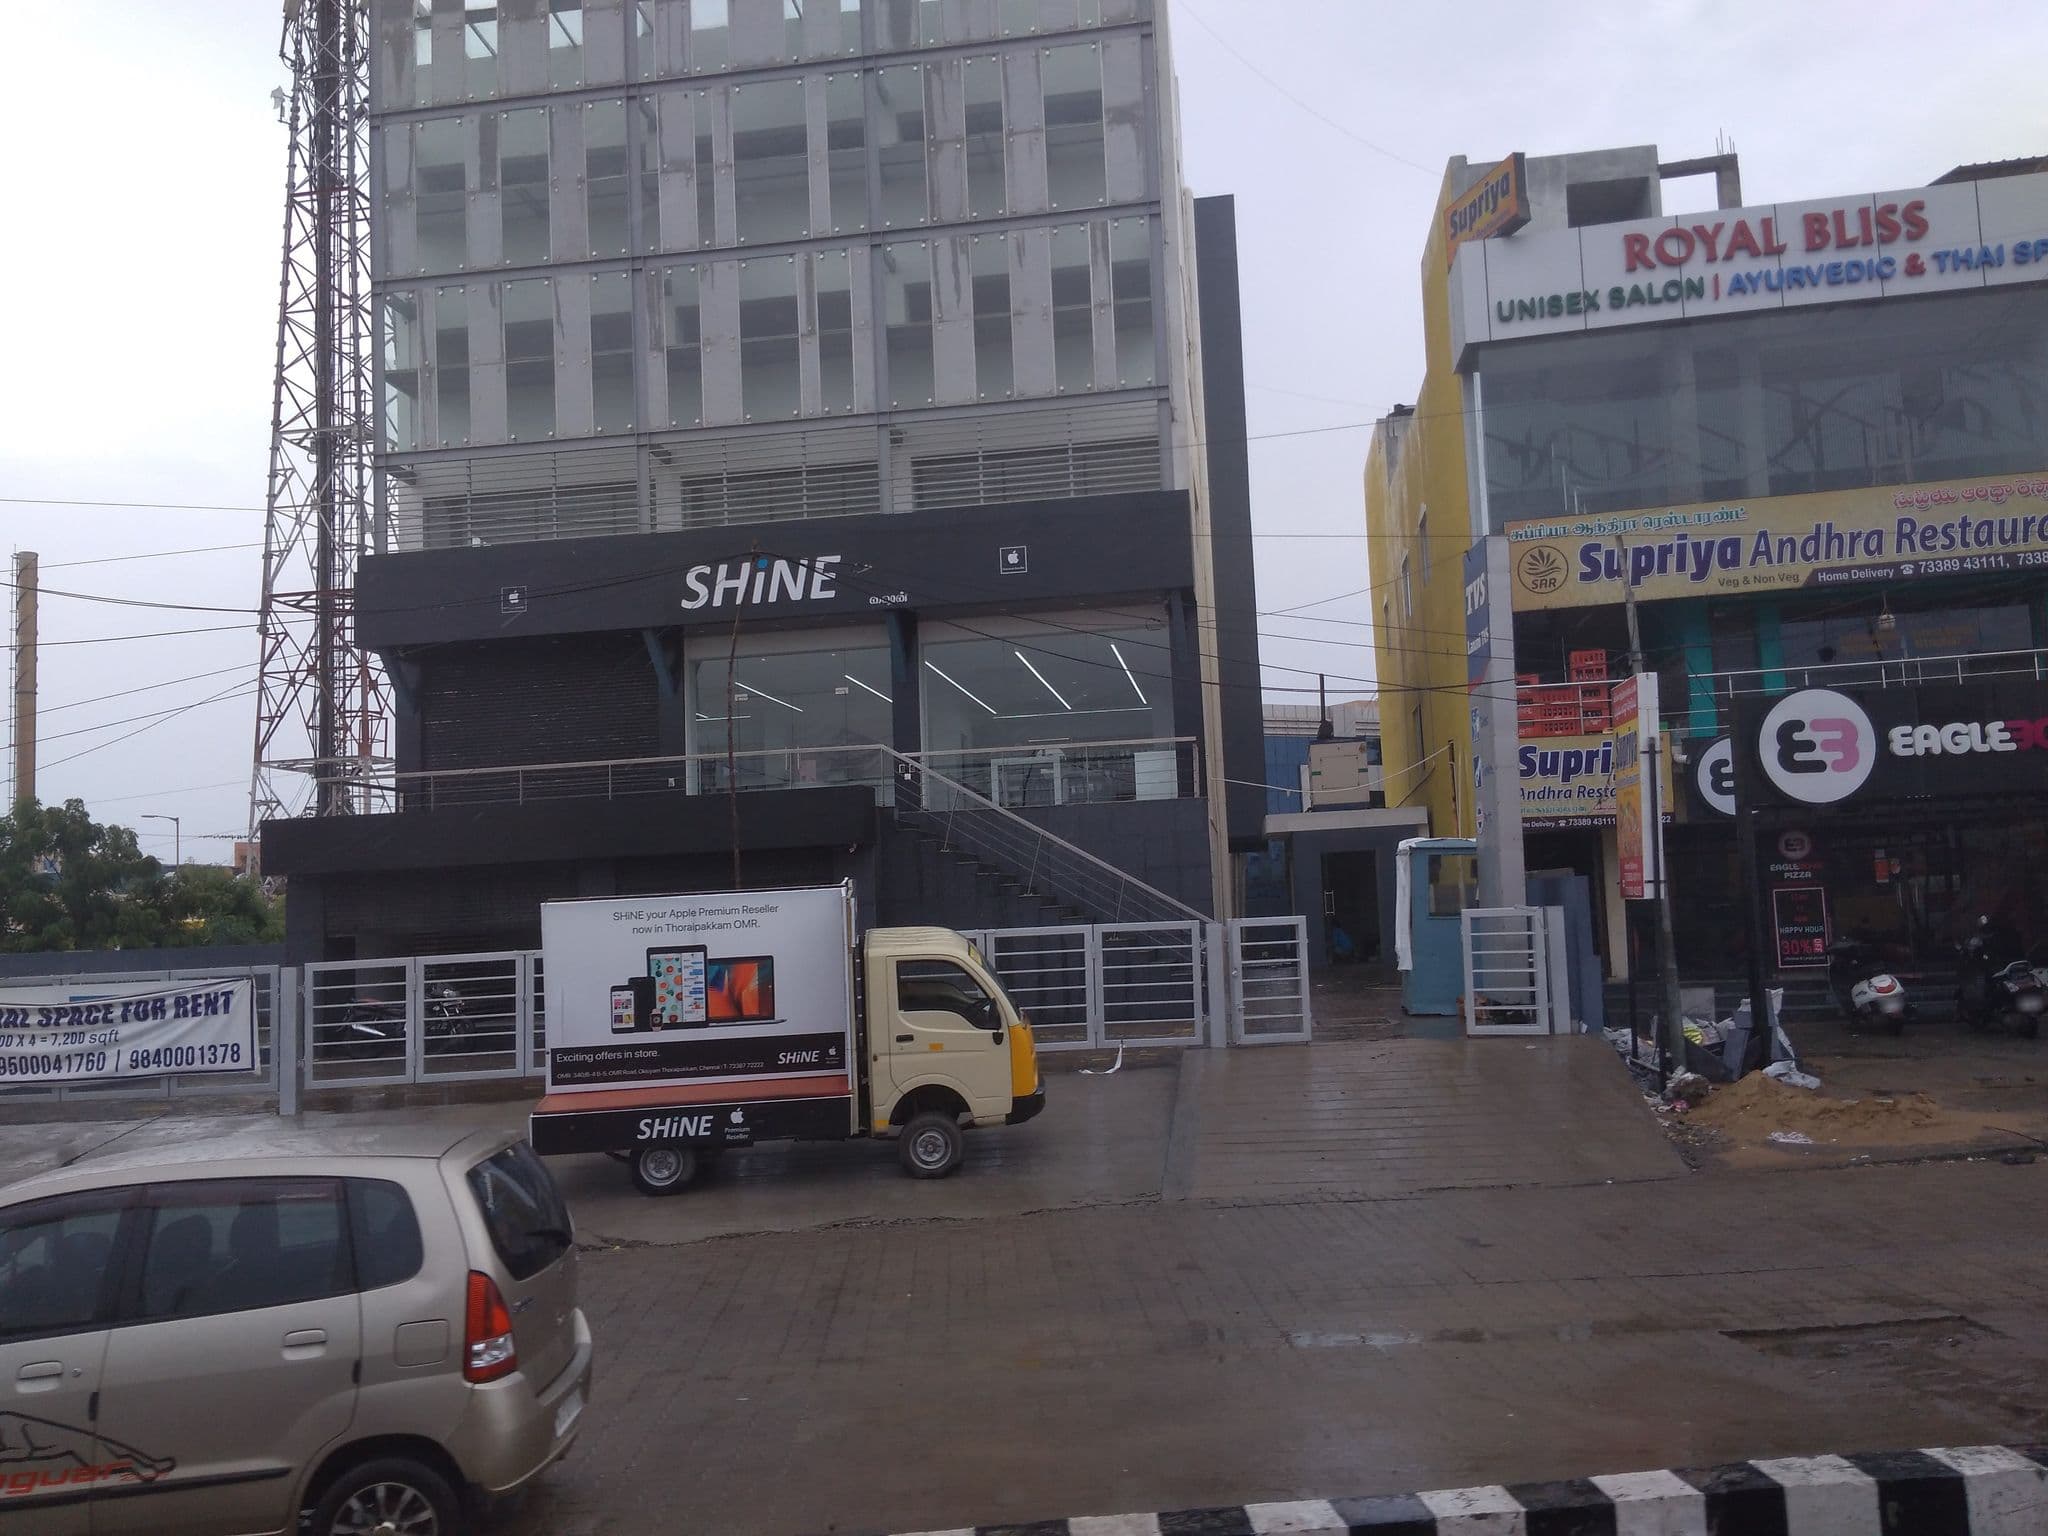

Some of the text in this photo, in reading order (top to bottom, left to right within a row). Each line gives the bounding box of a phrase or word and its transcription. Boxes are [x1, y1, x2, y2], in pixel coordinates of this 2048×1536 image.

[1450, 172, 1509, 240] Supriya
[1624, 200, 1929, 273] ROYAL BLISS
[1496, 288, 1601, 323] UNISEX
[1608, 275, 1705, 310] SALON
[1727, 256, 1897, 297] AYURVEDIC
[1904, 253, 1927, 277] &
[1931, 244, 2006, 273] THAI
[1578, 533, 1742, 587] Supriya
[1748, 521, 1884, 567] Andhra
[1718, 573, 1799, 587] Veg & Non Veg
[1817, 571, 1849, 583] Home
[1851, 567, 1894, 581] Delivery
[1919, 558, 1960, 574] 73389
[1964, 555, 2010, 571] 43111,
[1465, 572, 1485, 616] TVS
[1531, 578, 1557, 590] SAR
[1519, 741, 1616, 784] Supri
[1520, 785, 1572, 801] Andhra
[1784, 871, 1811, 880] PIZZA
[647, 911, 667, 921] your
[669, 908, 696, 919] Apple
[699, 905, 740, 917] Premium
[742, 904, 779, 915] Reseller
[632, 926, 652, 934] now
[654, 924, 663, 933] in
[734, 919, 760, 929] OMR.
[1780, 925, 1824, 935] HAPPY HOUR
[37, 1003, 114, 1028] SPACE
[121, 999, 166, 1023] FOR
[173, 990, 234, 1019] RENT
[28, 1034, 36, 1047] 4
[51, 1032, 85, 1048] 7,200
[88, 1029, 119, 1048] sqft
[129, 1043, 241, 1070] 9840001378
[556, 1048, 660, 1064] Exciting offers in store.
[0, 1461, 133, 1494] guar
